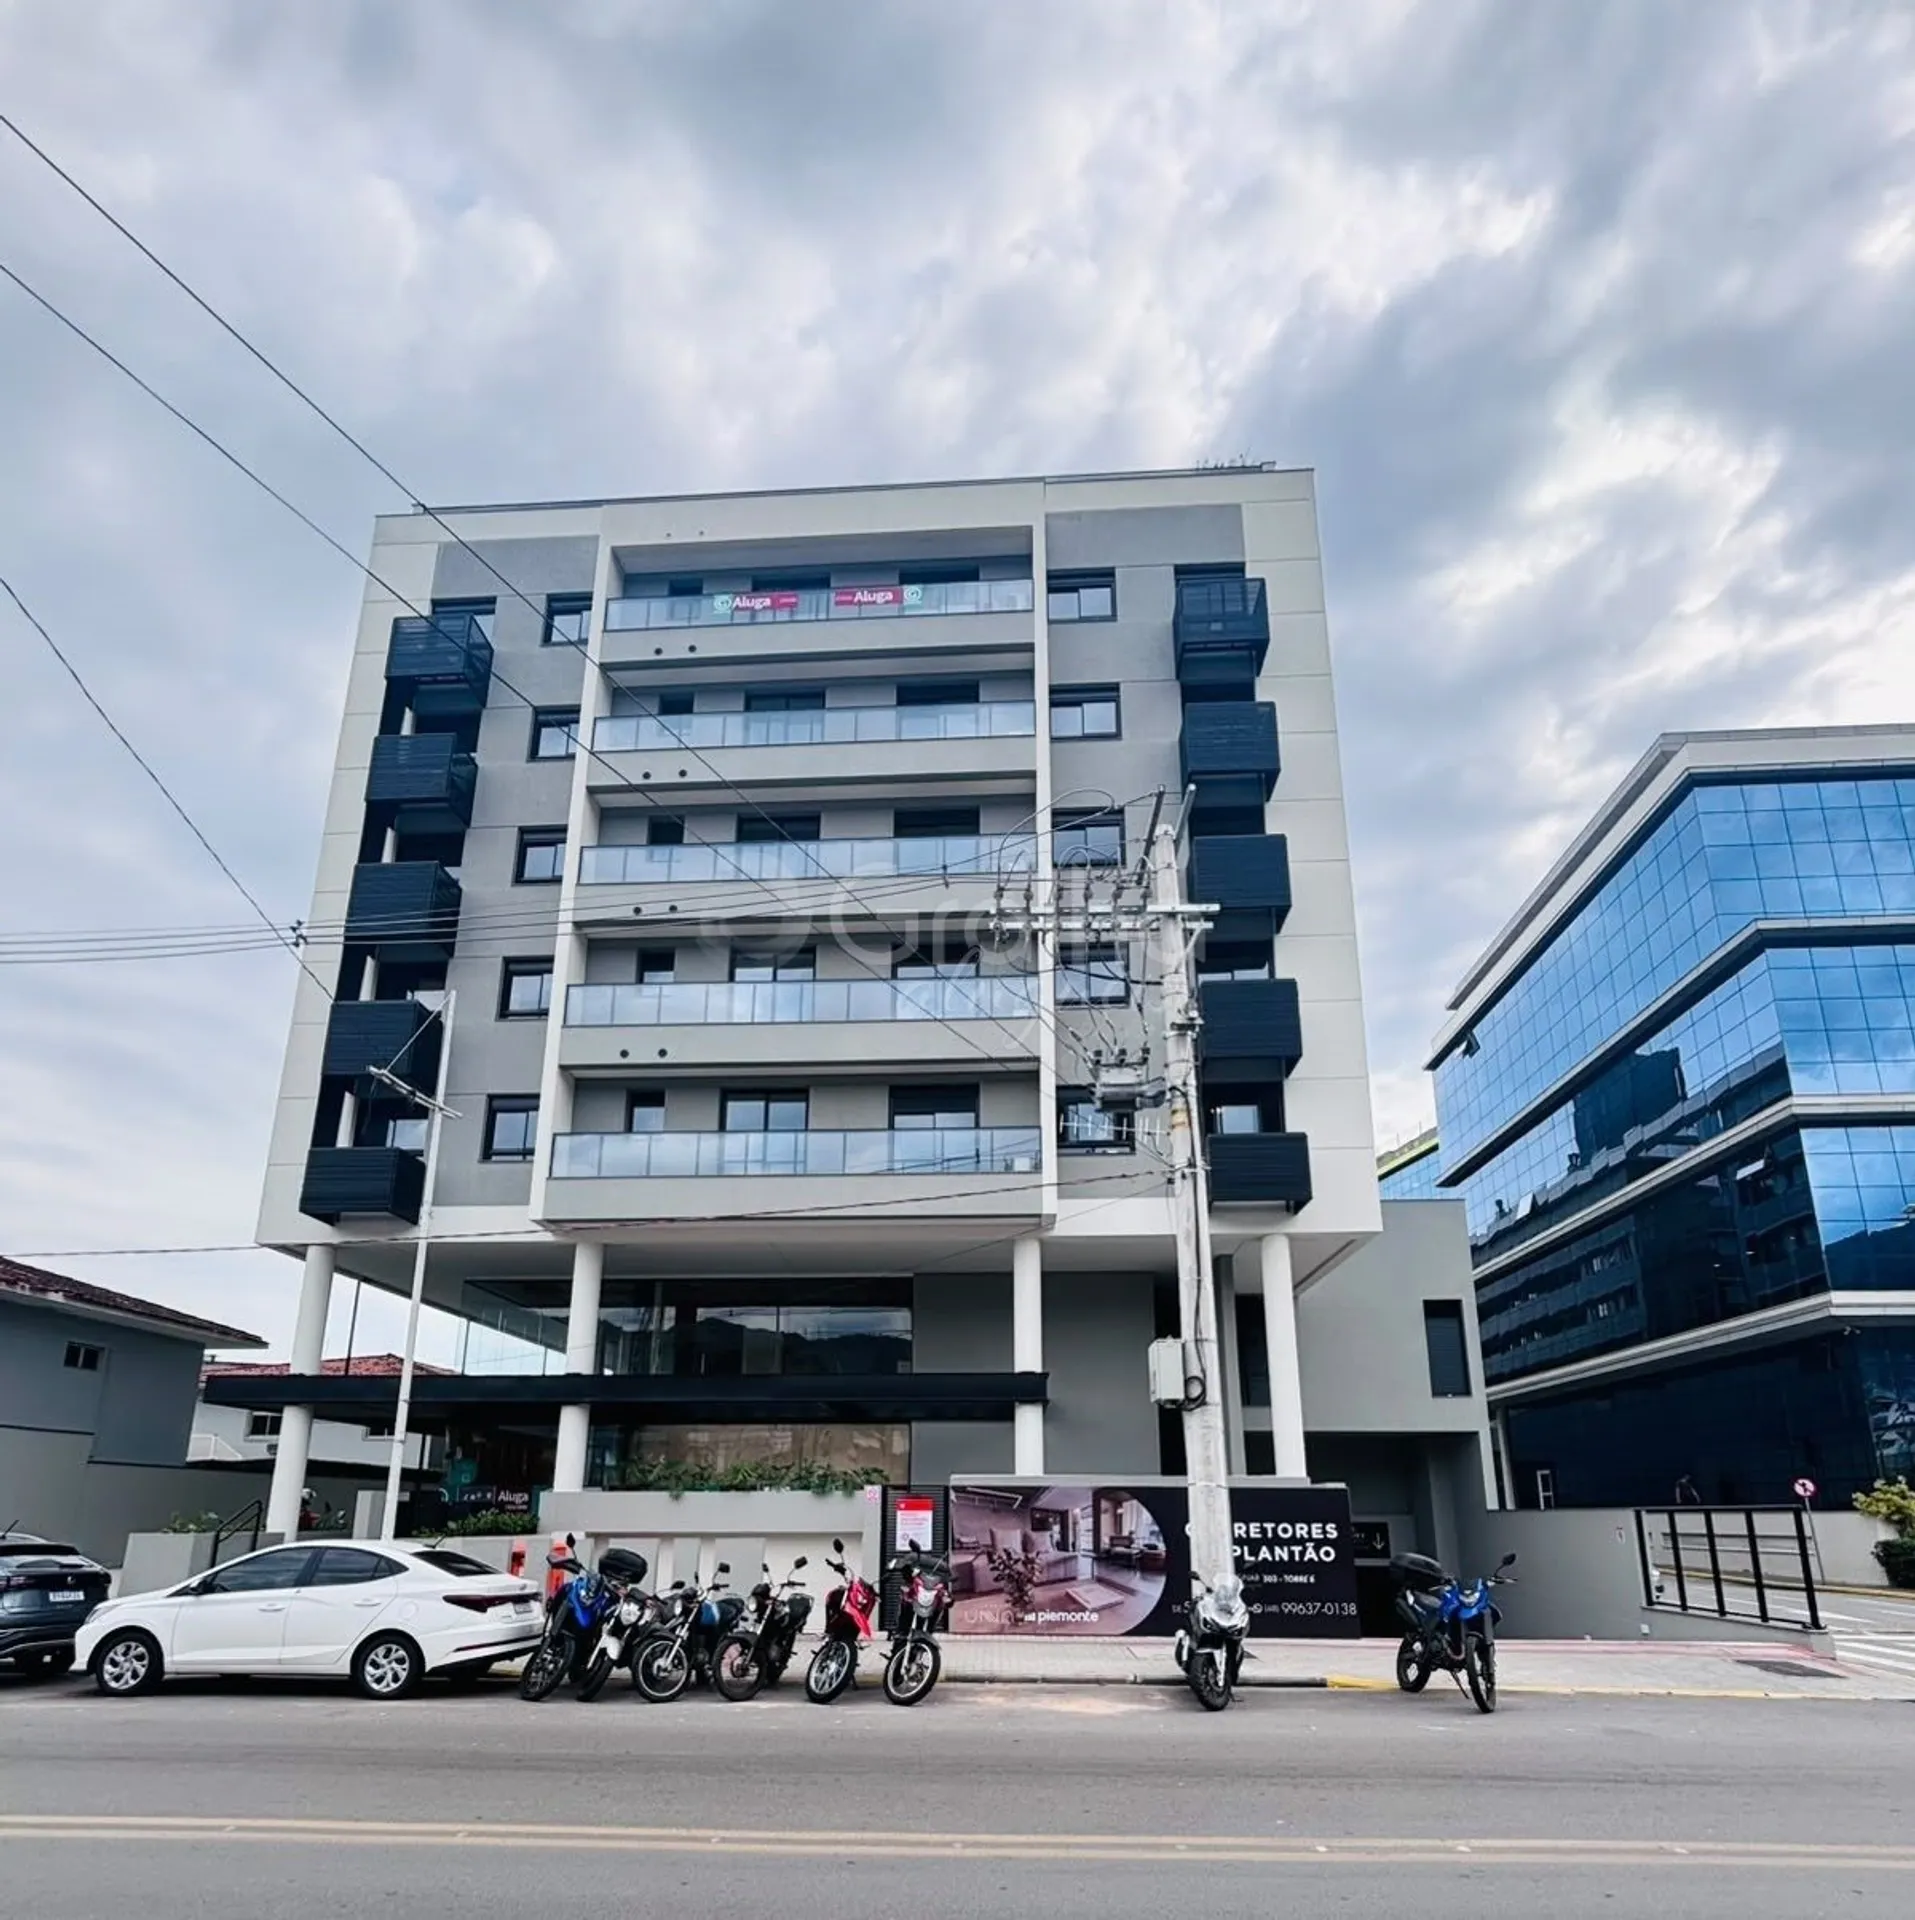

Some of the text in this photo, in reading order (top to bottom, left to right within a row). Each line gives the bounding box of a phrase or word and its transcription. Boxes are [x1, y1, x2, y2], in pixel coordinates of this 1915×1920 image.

[731, 595, 771, 611] Aluga
[853, 589, 893, 604] Aluga
[498, 1490, 529, 1504] Aluga
[1281, 1602, 1357, 1615] 99637-0138
[1037, 1608, 1099, 1625] piemonte
